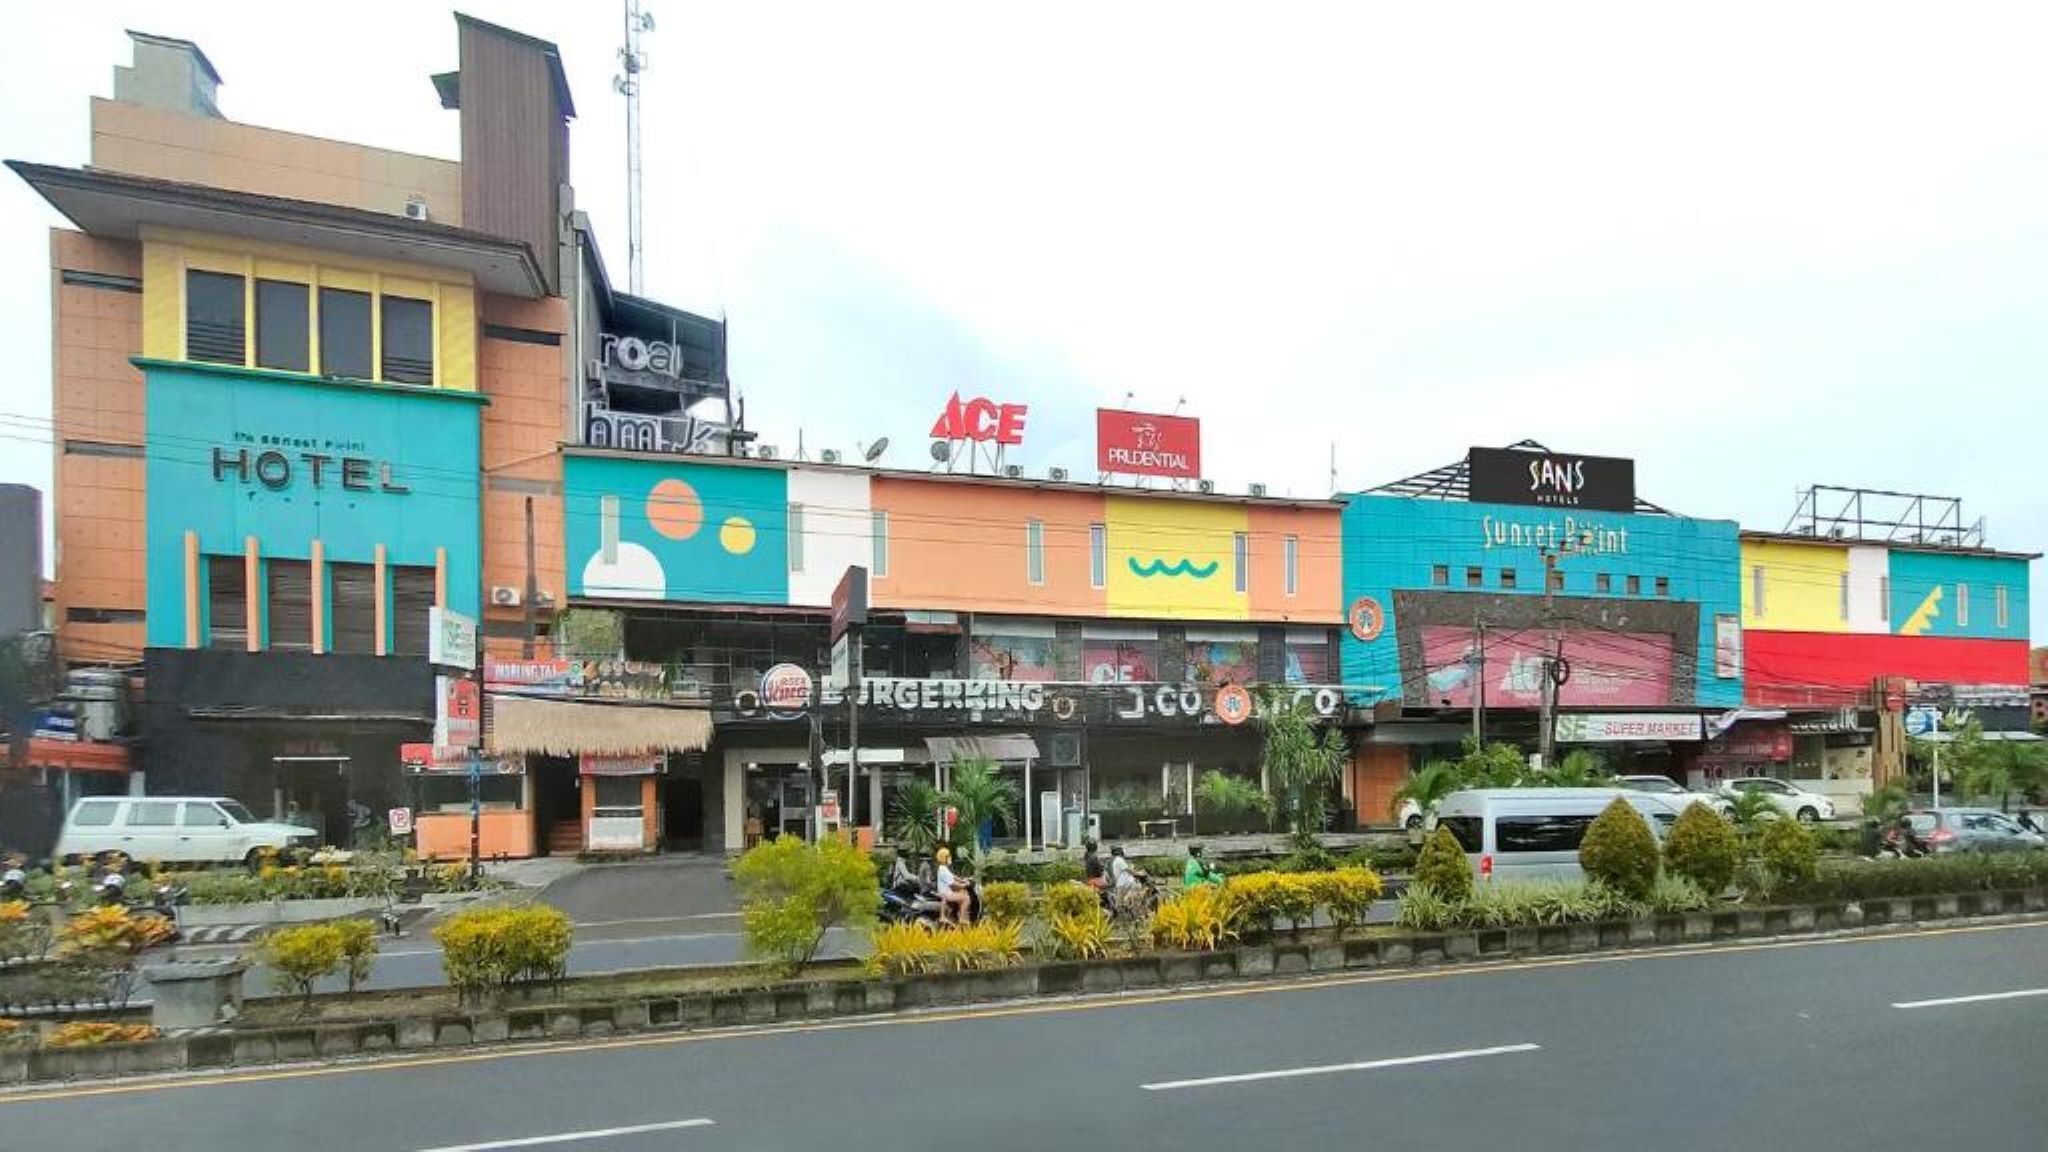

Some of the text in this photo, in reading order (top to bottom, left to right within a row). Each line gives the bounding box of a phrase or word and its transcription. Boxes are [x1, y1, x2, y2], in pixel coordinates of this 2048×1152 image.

[929, 389, 1028, 444] ACE
[212, 447, 412, 495] HOTEL
[1108, 447, 1189, 471] PRUDENTIAL
[1529, 459, 1585, 493] SANS
[1483, 514, 1557, 549] Sunset
